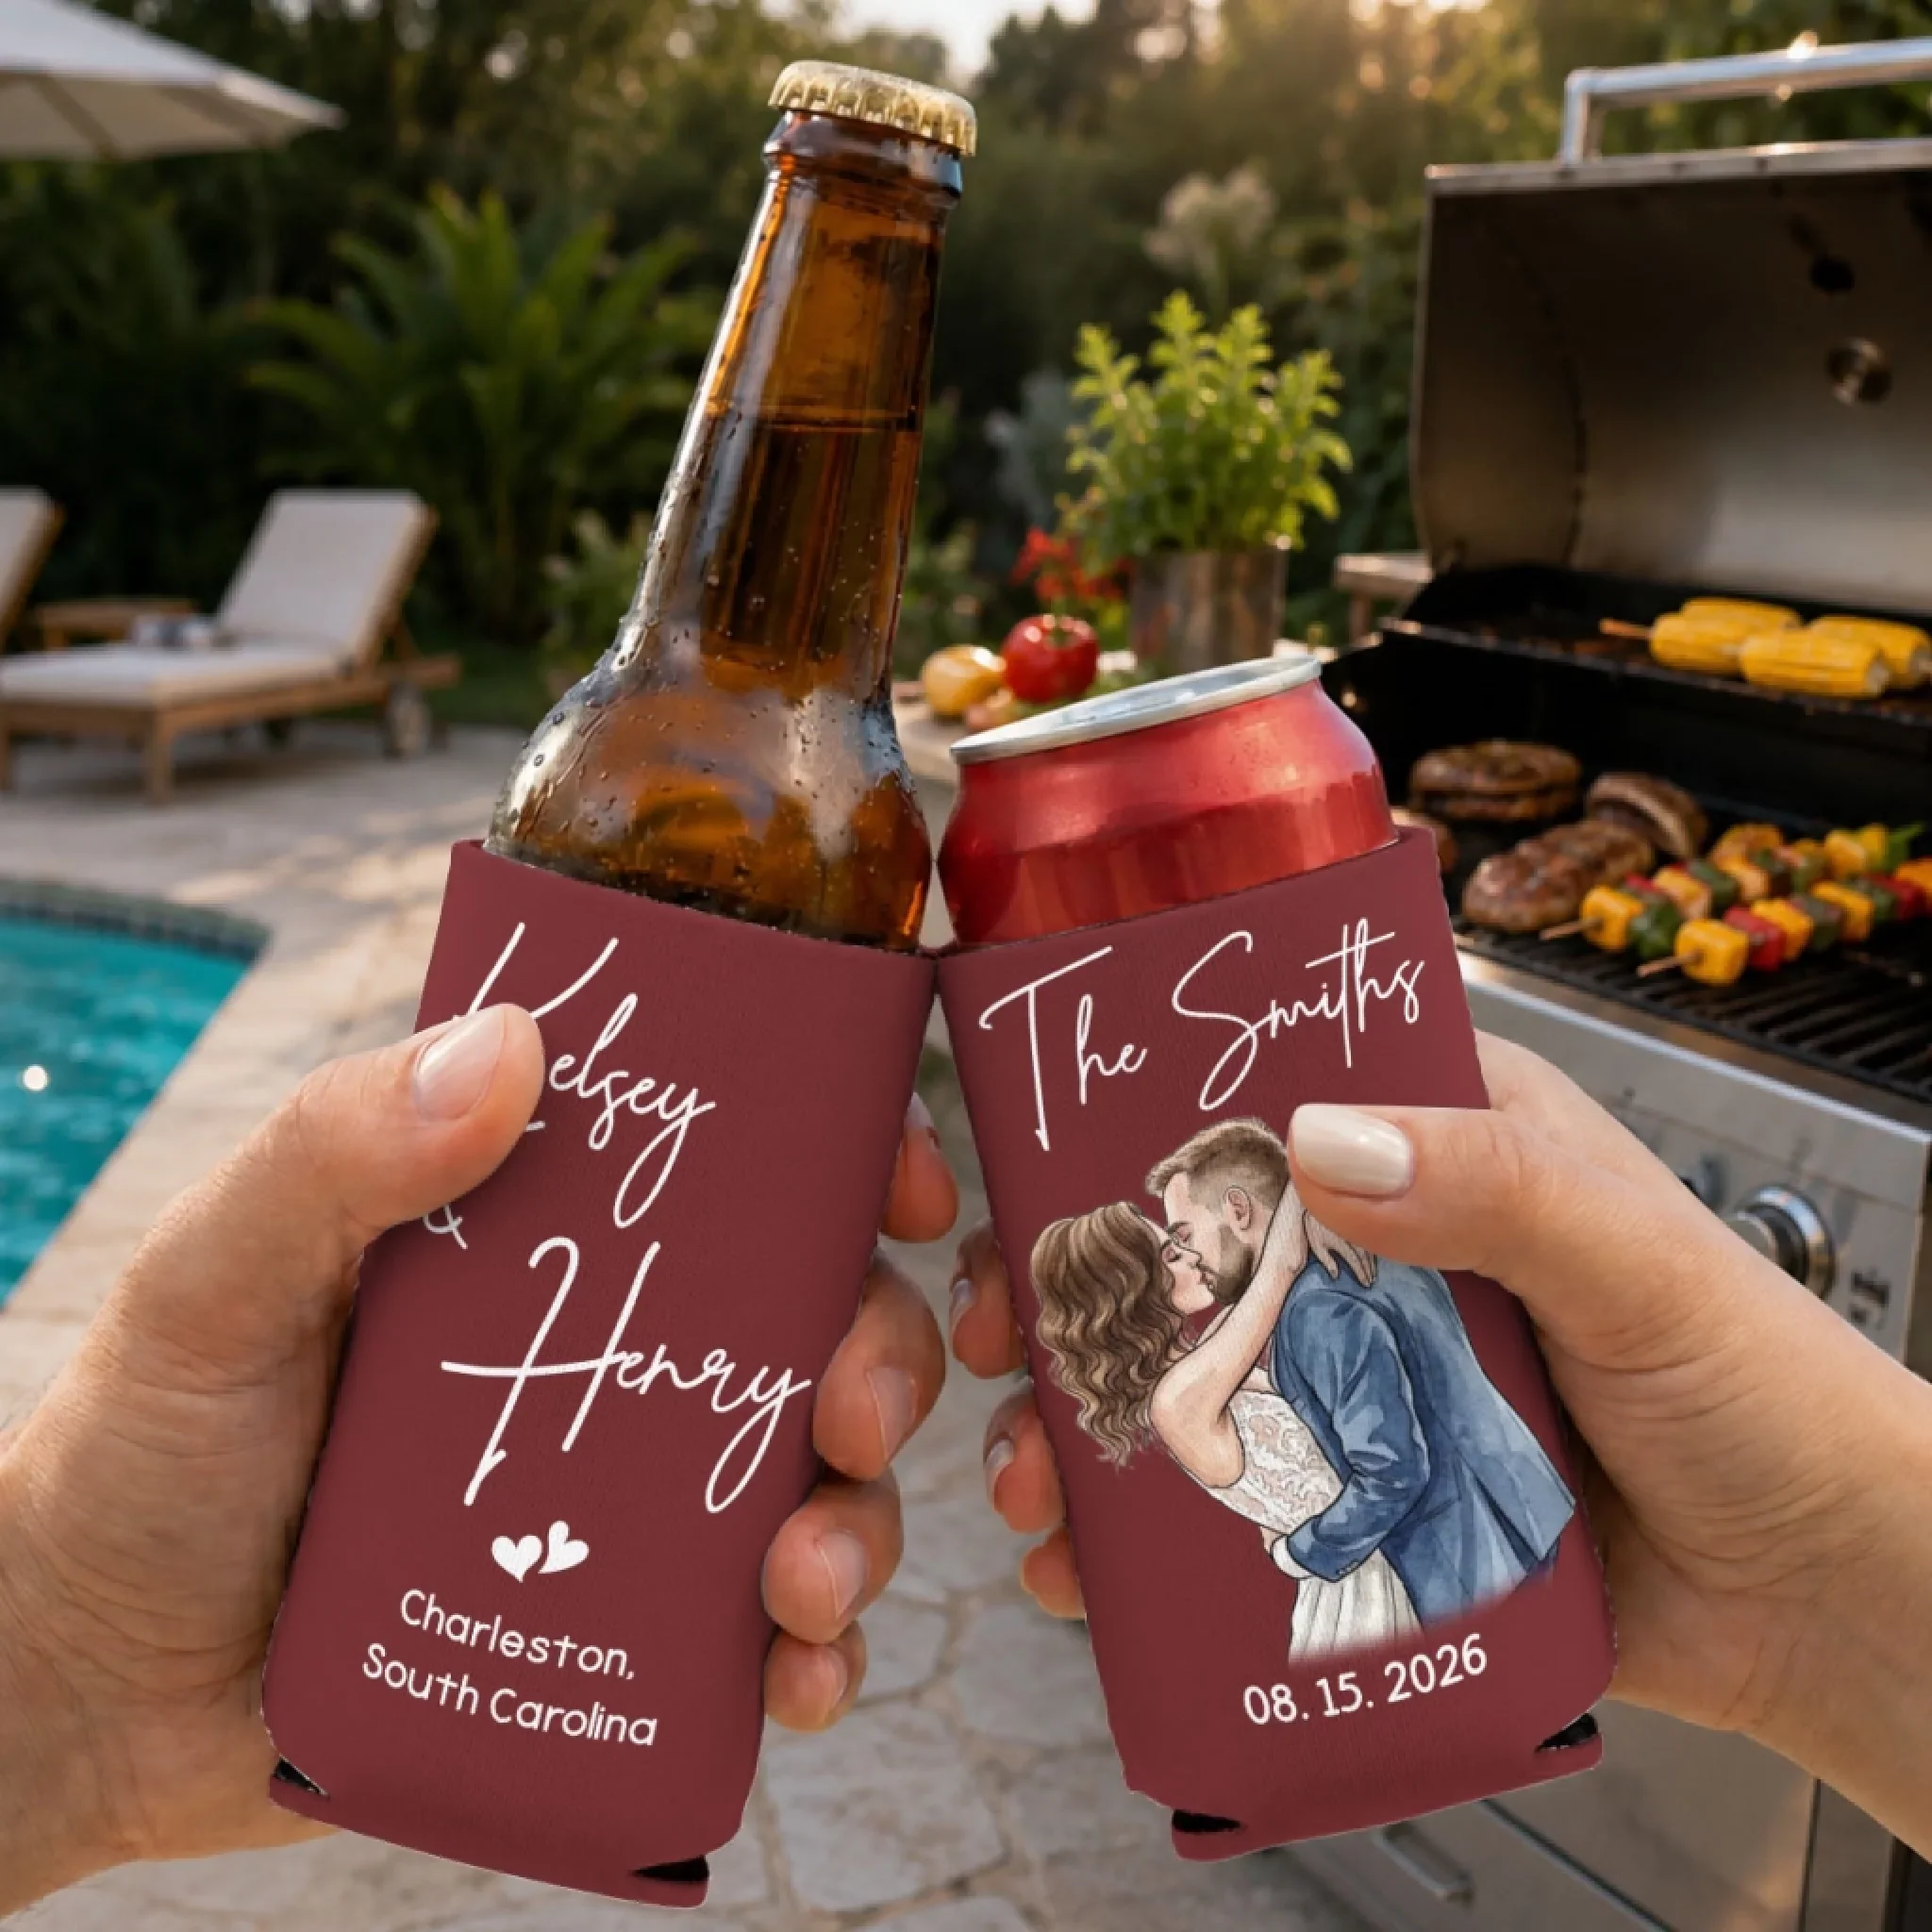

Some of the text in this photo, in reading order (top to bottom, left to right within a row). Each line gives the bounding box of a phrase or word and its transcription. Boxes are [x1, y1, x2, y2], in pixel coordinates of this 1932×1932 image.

[978, 917, 1425, 1152] The Smiths
[441, 1237, 812, 1514] Henry
[400, 1589, 635, 1680] Charleston,
[1384, 1633, 1488, 1703] 2026
[362, 1642, 658, 1747] South Carolina
